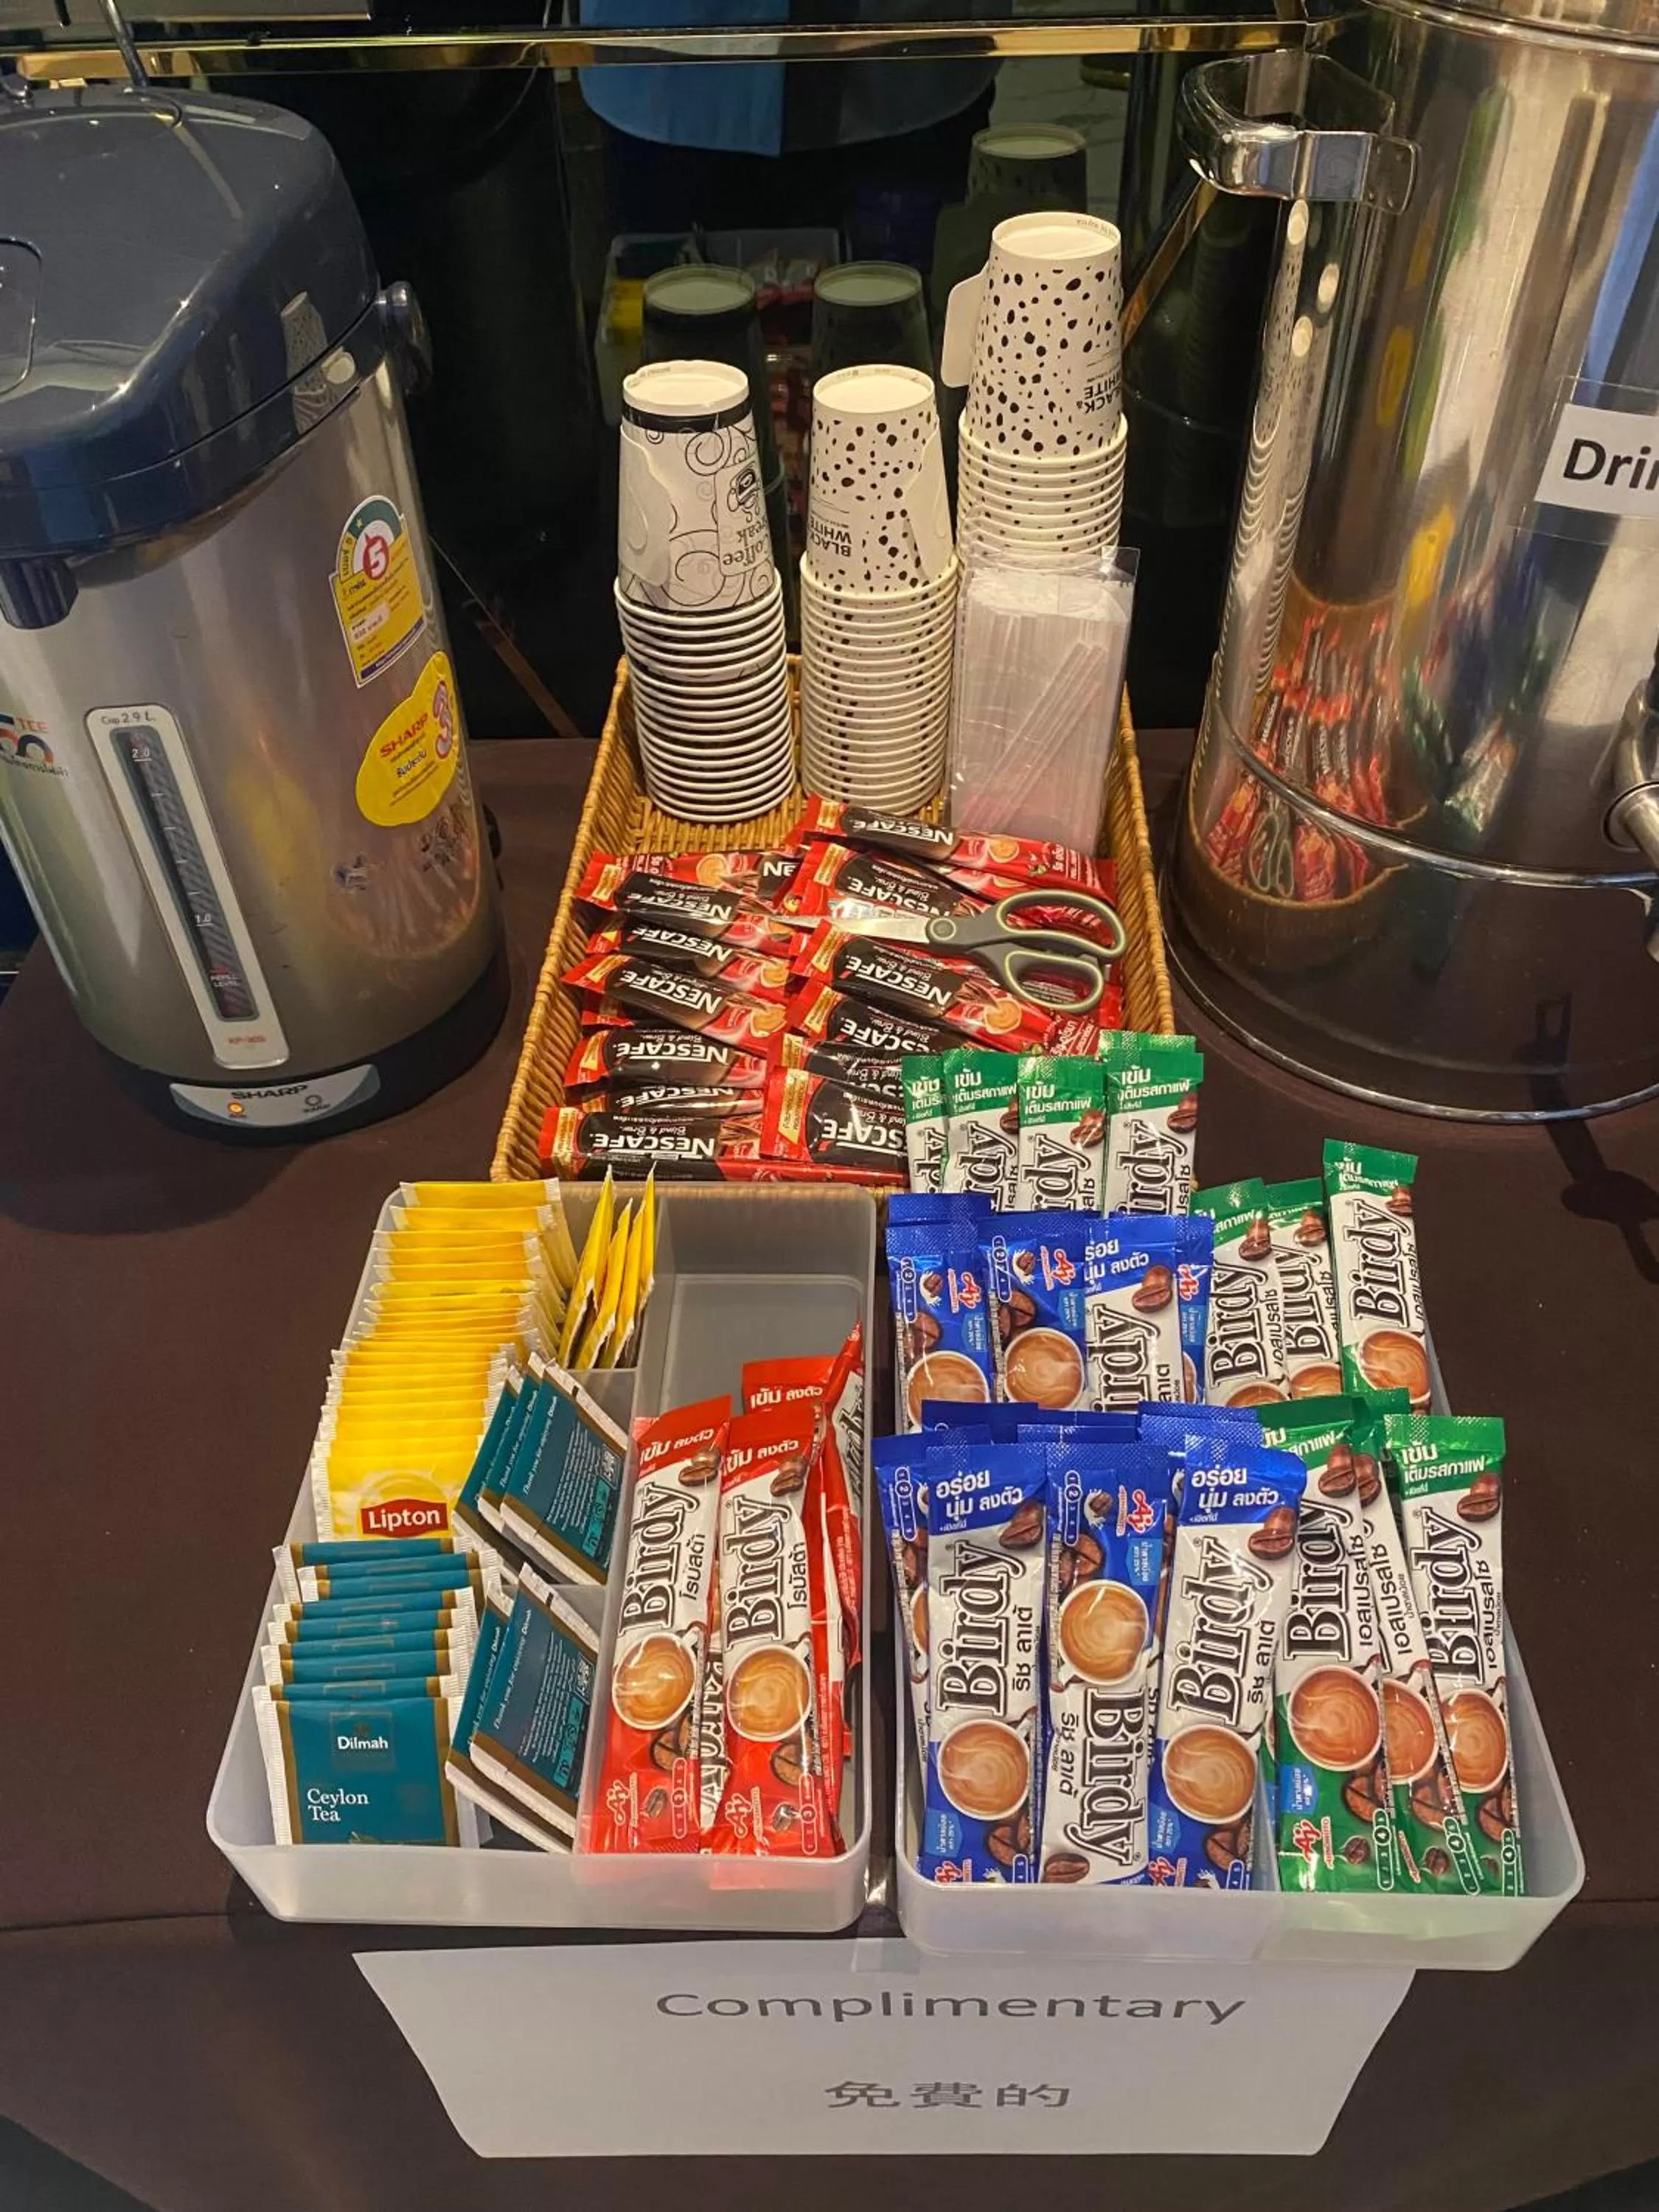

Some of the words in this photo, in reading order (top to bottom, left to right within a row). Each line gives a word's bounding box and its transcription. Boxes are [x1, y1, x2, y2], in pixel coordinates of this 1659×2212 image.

[617, 970, 723, 1015] NESCAFÉ
[839, 956, 952, 1006] NESCAFÉ
[613, 1041, 728, 1066] NESCAFÉ
[230, 1084, 308, 1099] SHARP
[589, 1133, 715, 1157] NESCAFÉ
[820, 1119, 907, 1150] SCAFÉ
[1116, 1119, 1188, 1216] irdy
[1085, 1238, 1119, 1262] ร่อย
[1344, 1197, 1411, 1329] Birdy
[1207, 1259, 1268, 1388] Birdy
[1086, 1305, 1161, 1411] irdy
[1400, 1440, 1439, 1465] เข้ม
[936, 1470, 991, 1499] อร่อย
[1191, 1464, 1248, 1487] อร่อย
[1404, 1455, 1485, 1484] เต็มรสกาแฟ
[946, 1495, 973, 1521] นุ่ม
[978, 1486, 1023, 1511] ลงตัว
[1198, 1487, 1228, 1513] นุ่ม
[1232, 1487, 1279, 1506] ลงตัว
[369, 1509, 441, 1531] Lipton
[617, 1482, 700, 1637] Birdy
[723, 1495, 792, 1650] Birdy
[1283, 1498, 1354, 1662] Birdy
[1411, 1506, 1482, 1686] Birdy
[936, 1540, 1026, 1716] Birdy
[1167, 1535, 1273, 1725] Birdy
[337, 1735, 389, 1750] Dilmah
[1062, 1688, 1147, 1866] Birdy
[307, 1787, 369, 1809] Ceylon
[307, 1805, 341, 1822] Tea
[655, 1992, 1247, 2025] Complimentary
[824, 2081, 1071, 2110] 免費的
